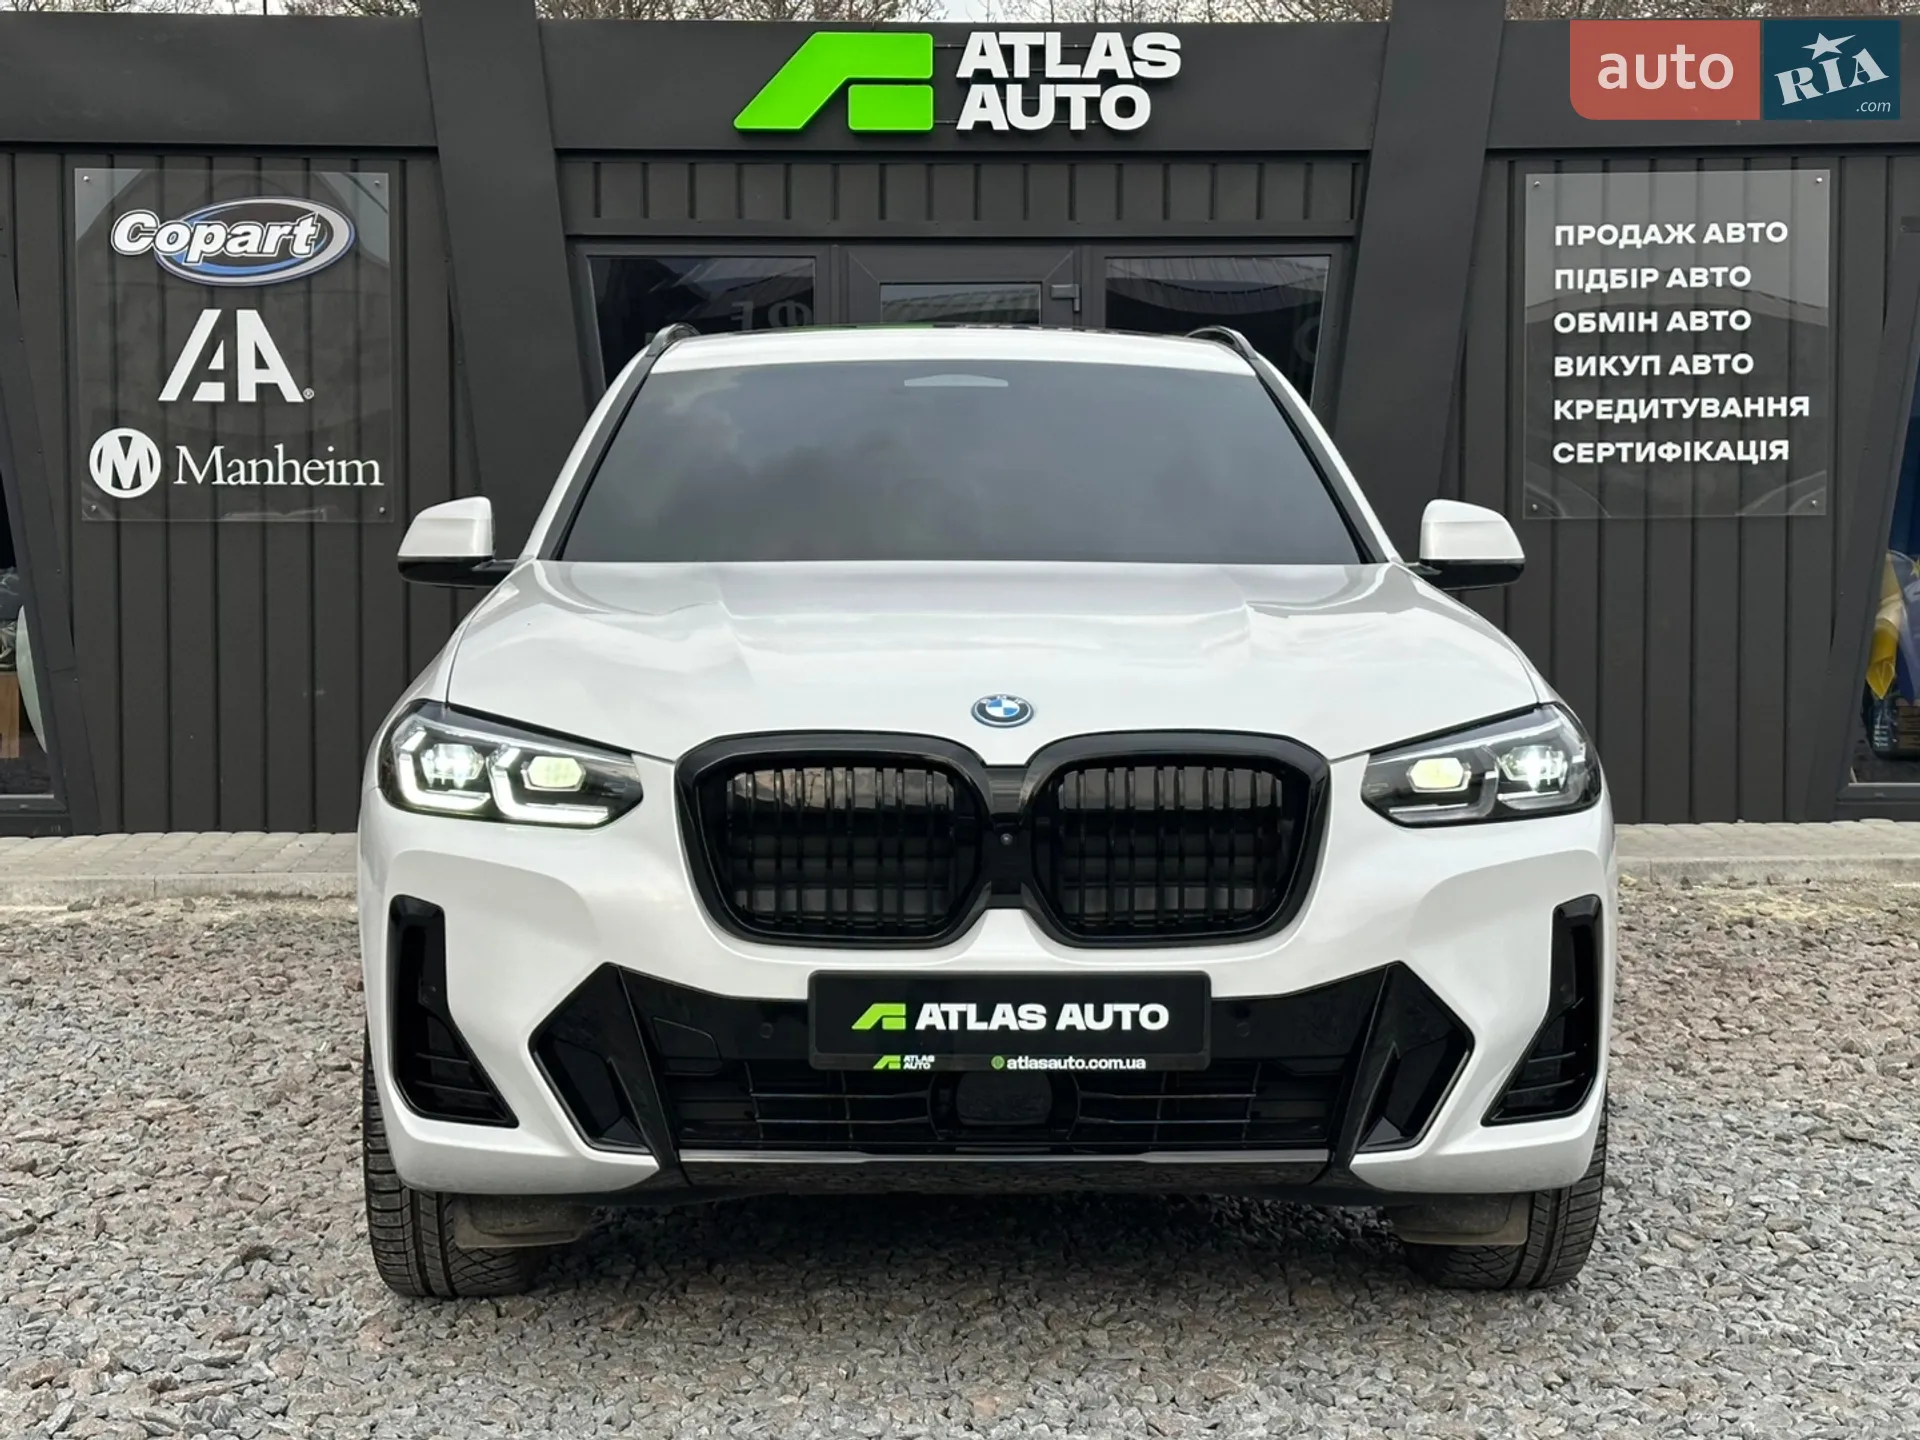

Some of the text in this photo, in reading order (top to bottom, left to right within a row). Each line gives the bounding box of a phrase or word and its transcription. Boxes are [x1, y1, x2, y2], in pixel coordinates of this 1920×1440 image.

[956, 31, 1182, 78] ATLAS
[956, 84, 1152, 131] AUTO
[112, 209, 318, 265] Copart
[1555, 221, 1788, 249] ПРОДАЖ АВТО
[1555, 265, 1752, 294] ПІДБІР АВТО
[1554, 309, 1752, 333] ОБМІН АВТО
[1554, 353, 1754, 377] ВИКУП АВТО
[1554, 396, 1810, 423] КРЕДИТУВАННЯ
[173, 443, 384, 487] Manheim
[1552, 439, 1789, 465] СЕРТИФІКАЦІЯ
[915, 1003, 1170, 1031] ATLAS AUTO
[903, 1062, 932, 1070] AUTO
[1006, 1055, 1147, 1070] atlasauto.com.ua
